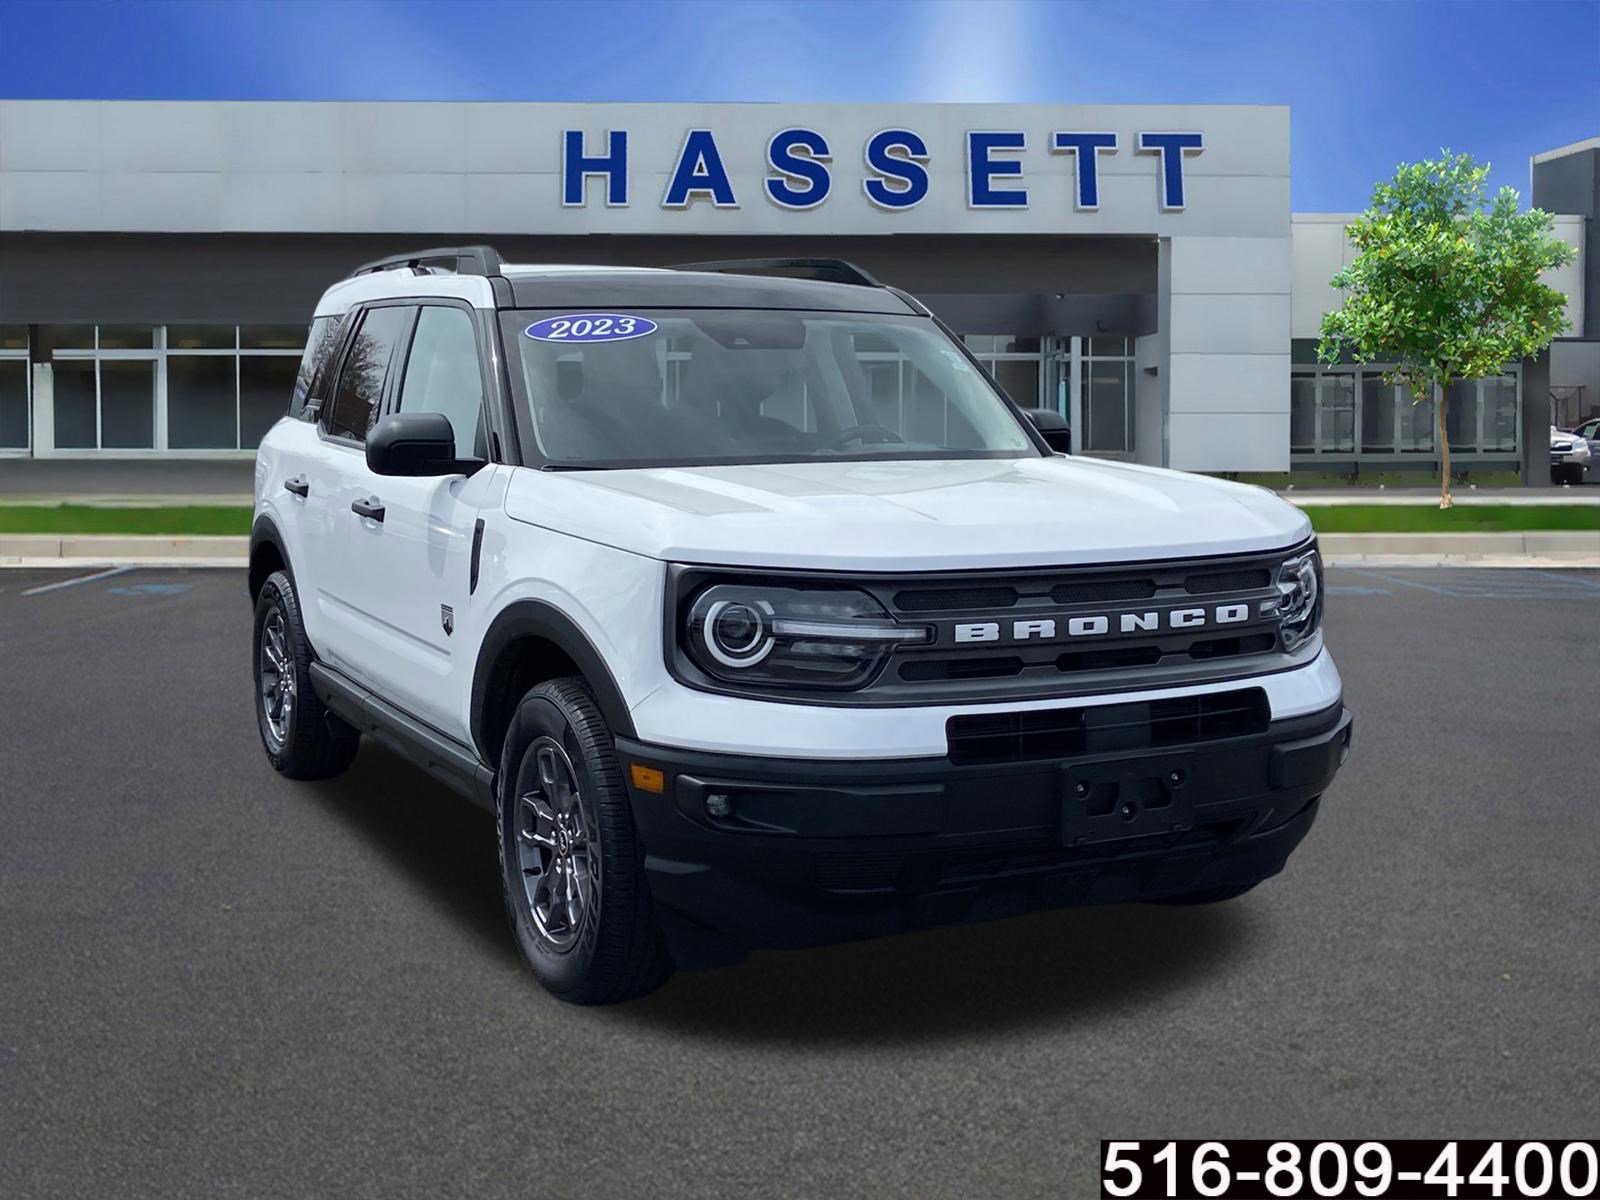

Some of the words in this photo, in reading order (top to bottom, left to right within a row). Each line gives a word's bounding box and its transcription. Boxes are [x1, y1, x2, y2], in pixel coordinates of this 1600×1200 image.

[561, 128, 1204, 211] HASSETT
[547, 317, 637, 339] 2023
[954, 603, 1250, 643] BRONCO
